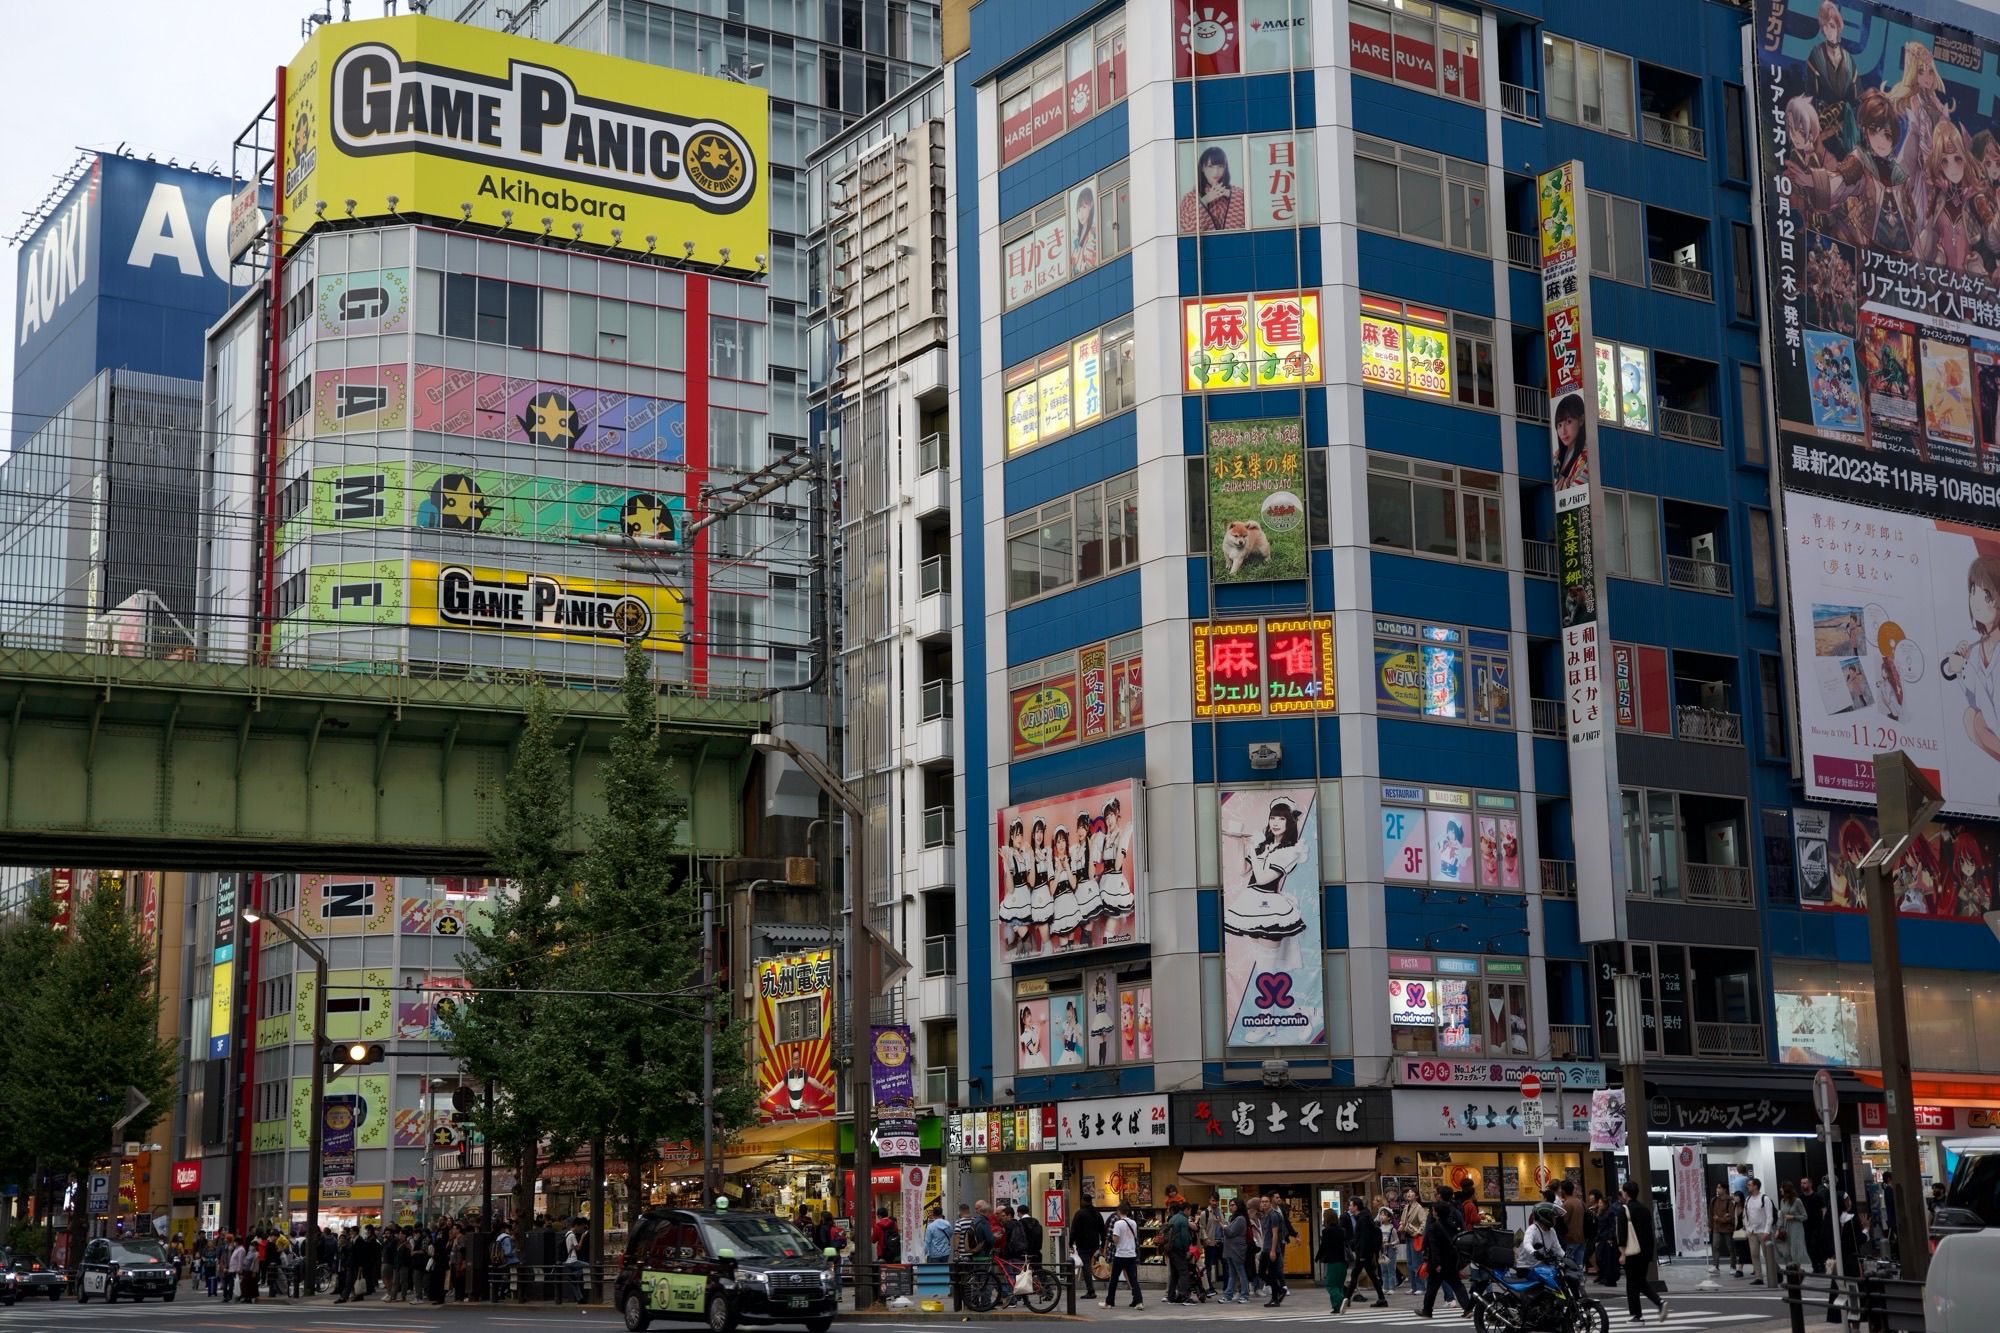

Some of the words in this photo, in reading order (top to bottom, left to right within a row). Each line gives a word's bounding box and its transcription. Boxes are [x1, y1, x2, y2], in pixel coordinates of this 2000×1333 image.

[1263, 17, 1305, 29] MAGIC
[1352, 38, 1390, 62] HARE
[1396, 51, 1434, 73] RUYA
[341, 46, 501, 146] GAME
[518, 72, 681, 181] PANIC
[1005, 122, 1031, 147] HARE
[1034, 105, 1062, 130] RUYA
[1769, 64, 1787, 166] リアセカイ
[1564, 167, 1572, 194] 三人打
[478, 174, 626, 222] Akihabara
[20, 190, 90, 347] AOKI
[1009, 263, 1064, 300] もみほぐし
[1546, 275, 1578, 301] 麻雀
[1203, 303, 1303, 348] 麻雀
[1362, 322, 1400, 350] 麻雀
[1871, 315, 1905, 331] ヴァンガード
[1554, 312, 1577, 386] ウェルカム
[1084, 359, 1098, 416] 三人打
[1214, 453, 1298, 479] 小豆柴の郷
[1791, 445, 1938, 497] 最新2023年11月号
[1222, 480, 1260, 493] AZUKISHIBA
[1264, 480, 1272, 490] NO
[1275, 478, 1292, 490] SATO
[1812, 513, 1904, 541] 青春ブタ野郎は
[1563, 513, 1582, 586] 小豆柴の郷
[1801, 535, 1919, 566] おでかけシスターの
[444, 571, 524, 620] GAME
[535, 580, 614, 627] PANIC
[1207, 637, 1317, 679] 麻雀
[1567, 631, 1582, 724] もみほぐし
[1582, 626, 1599, 721] 和風耳かき
[1616, 650, 1632, 720] ウェルカム
[1085, 671, 1105, 729] ウェルカム
[1211, 681, 1304, 701] ウェルカム
[1021, 703, 1070, 731] WELCOME
[1087, 727, 1104, 736] AKIBA
[1851, 724, 1897, 750] 11.29
[1901, 736, 1916, 748] ON
[1918, 737, 1938, 750] SALE
[1385, 789, 1420, 799] RESTAURANT
[1435, 791, 1451, 801] MAID
[1451, 793, 1463, 804] CAFE
[1385, 813, 1405, 840] 2F
[1404, 847, 1423, 874] 3F
[1401, 958, 1419, 969] PASTA
[1602, 964, 1618, 980] 3F
[762, 960, 831, 998] 九州電気
[1665, 982, 1681, 991] 32席
[1242, 1012, 1308, 1028] maidreamin
[1605, 1010, 1617, 1027] 2
[1663, 1015, 1682, 1030] 受付
[1423, 1065, 1434, 1077] 2F
[1438, 1066, 1449, 1078] 3F
[1079, 1108, 1142, 1139] 富士そば
[1152, 1106, 1166, 1121] 24
[1195, 1101, 1225, 1137] 名代
[1232, 1098, 1363, 1137] 富士そば
[1572, 1104, 1588, 1118] 24
[1867, 1109, 1879, 1120] B1
[1152, 1123, 1166, 1135] 時間
[94, 1178, 106, 1193] P
[176, 1168, 197, 1184] Rakuten
[878, 1176, 894, 1184] MOBILE
